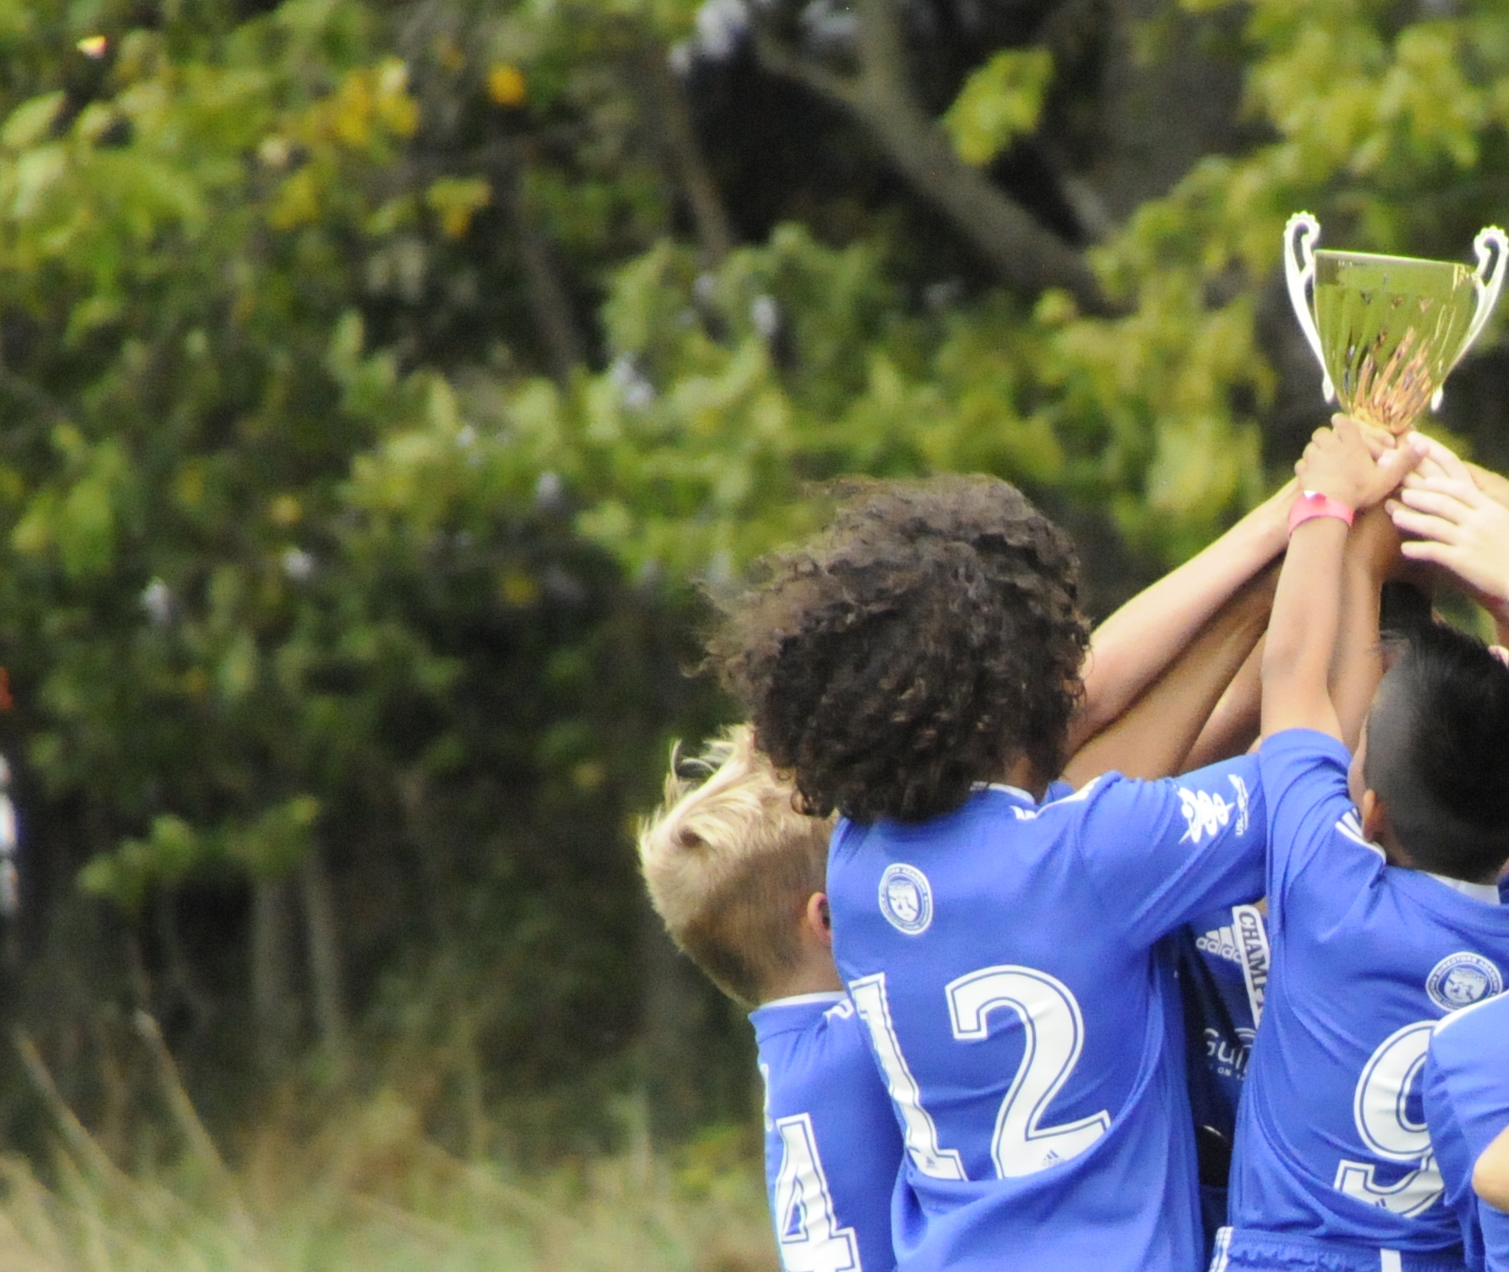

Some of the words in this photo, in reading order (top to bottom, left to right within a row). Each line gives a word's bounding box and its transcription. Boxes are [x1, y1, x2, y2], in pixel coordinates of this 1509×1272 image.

[1196, 937, 1243, 964] adida
[1238, 911, 1268, 1010] CHAMP
[848, 964, 1111, 1182] 12
[1334, 1020, 1446, 1218] 9
